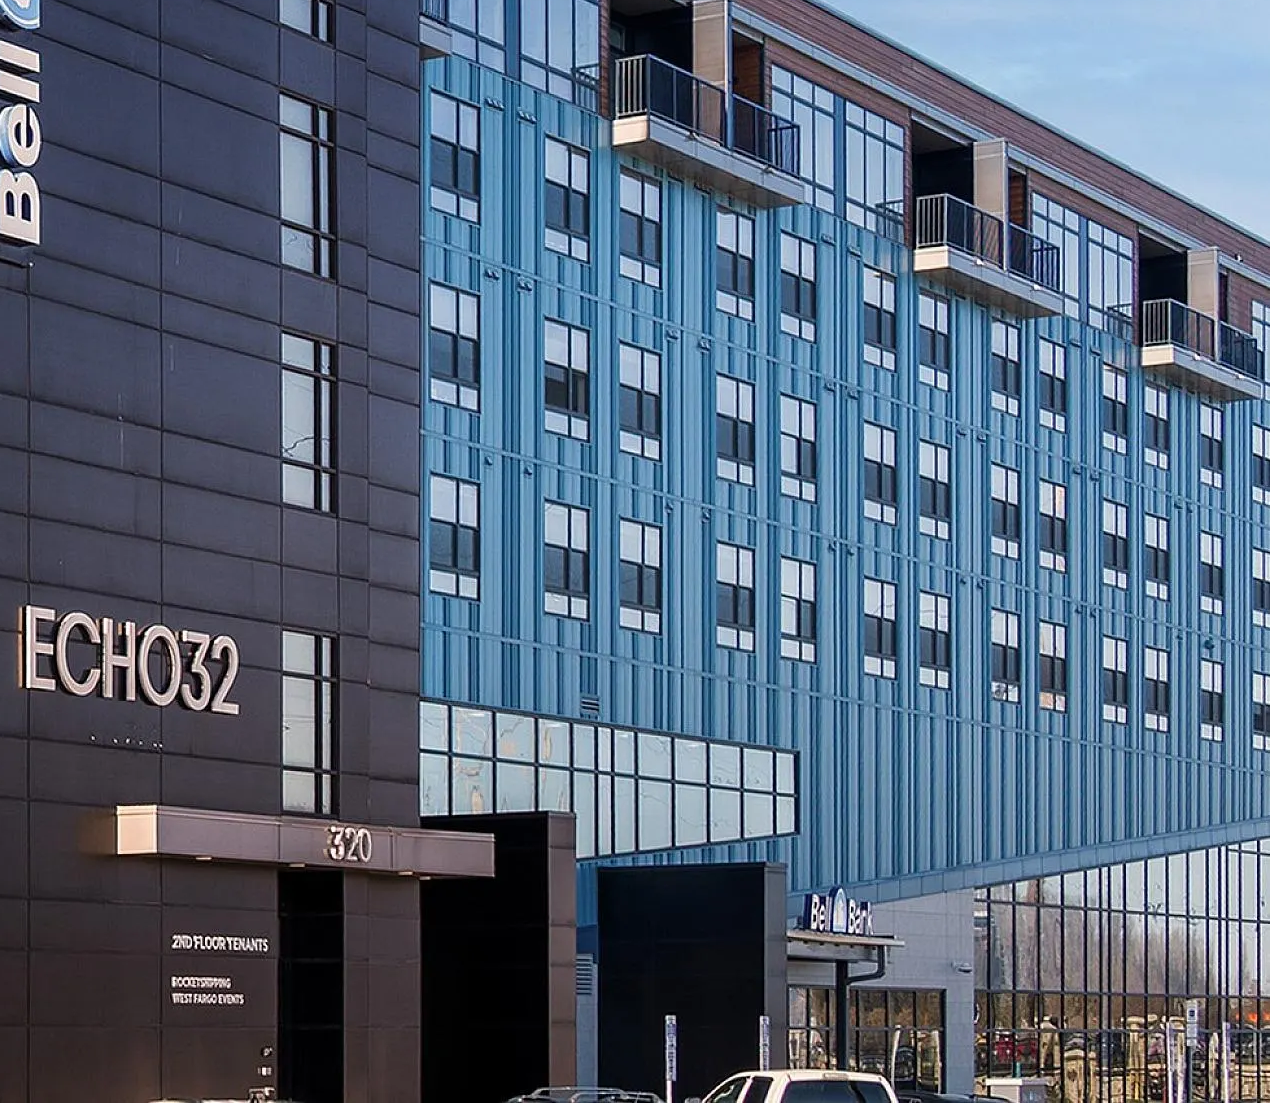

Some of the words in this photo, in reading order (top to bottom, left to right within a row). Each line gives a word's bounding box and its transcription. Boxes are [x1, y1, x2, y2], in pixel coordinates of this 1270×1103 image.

[24, 605, 240, 715] ECHO32
[329, 826, 372, 862] 320
[171, 934, 193, 949] 2ND
[193, 935, 226, 950] FLOOR
[226, 937, 269, 952] TENANTS
[171, 993, 192, 1004] WEST
[193, 993, 217, 1004] FARGO
[218, 994, 244, 1005] EVENTS
